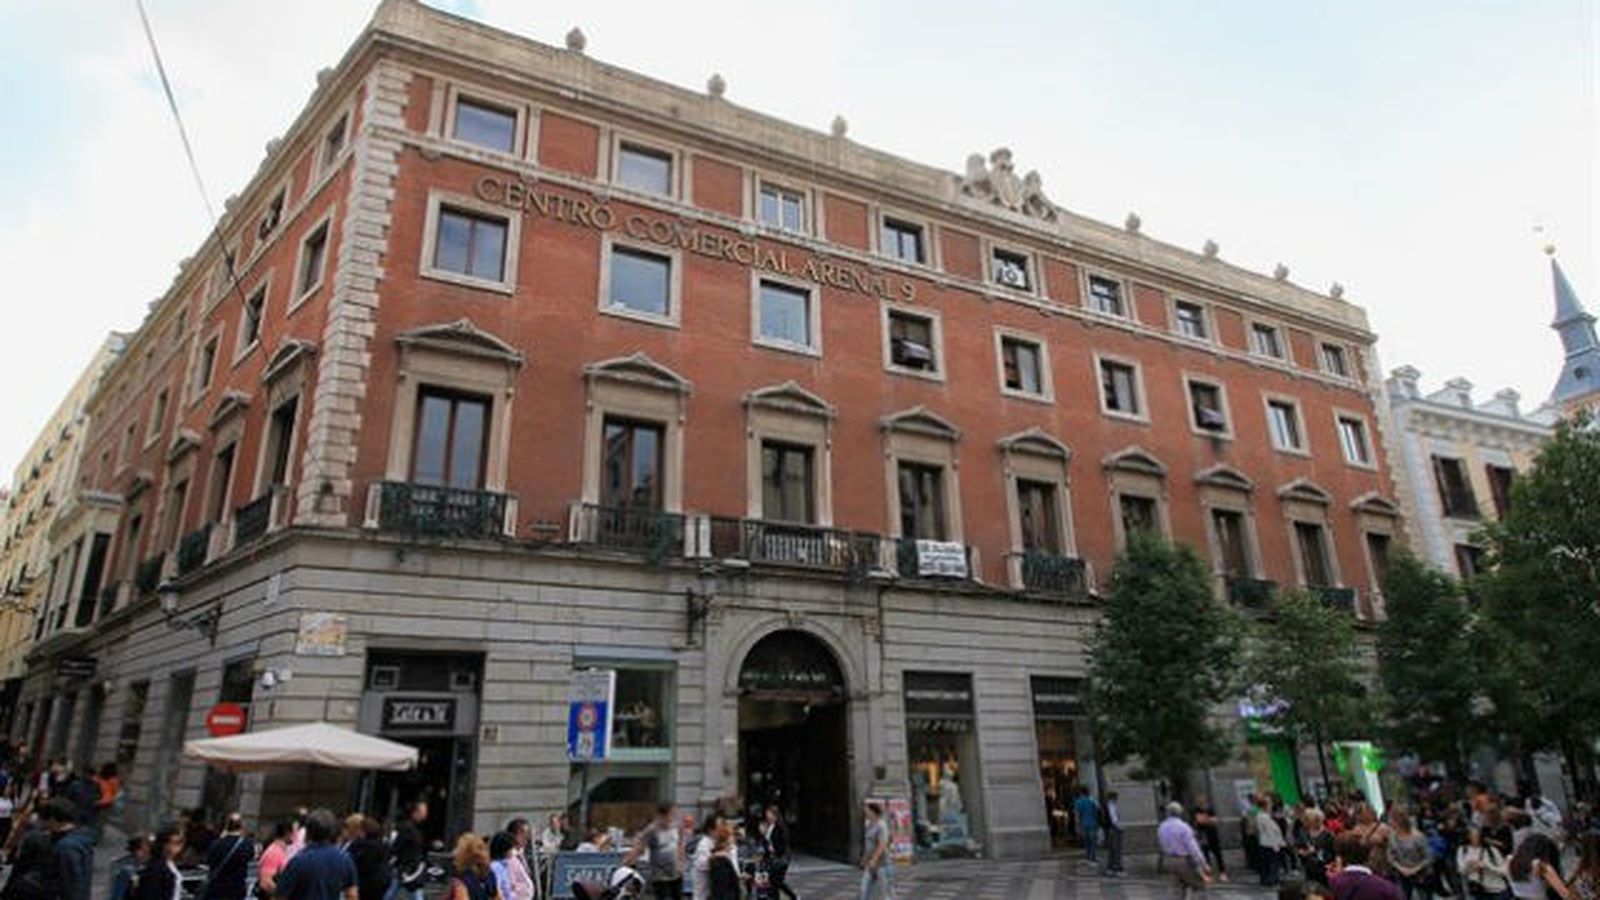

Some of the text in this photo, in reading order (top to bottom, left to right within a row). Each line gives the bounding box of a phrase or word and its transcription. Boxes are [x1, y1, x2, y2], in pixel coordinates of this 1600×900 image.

[475, 176, 917, 302] CENTRO COMERCIAL ARENAL 9
